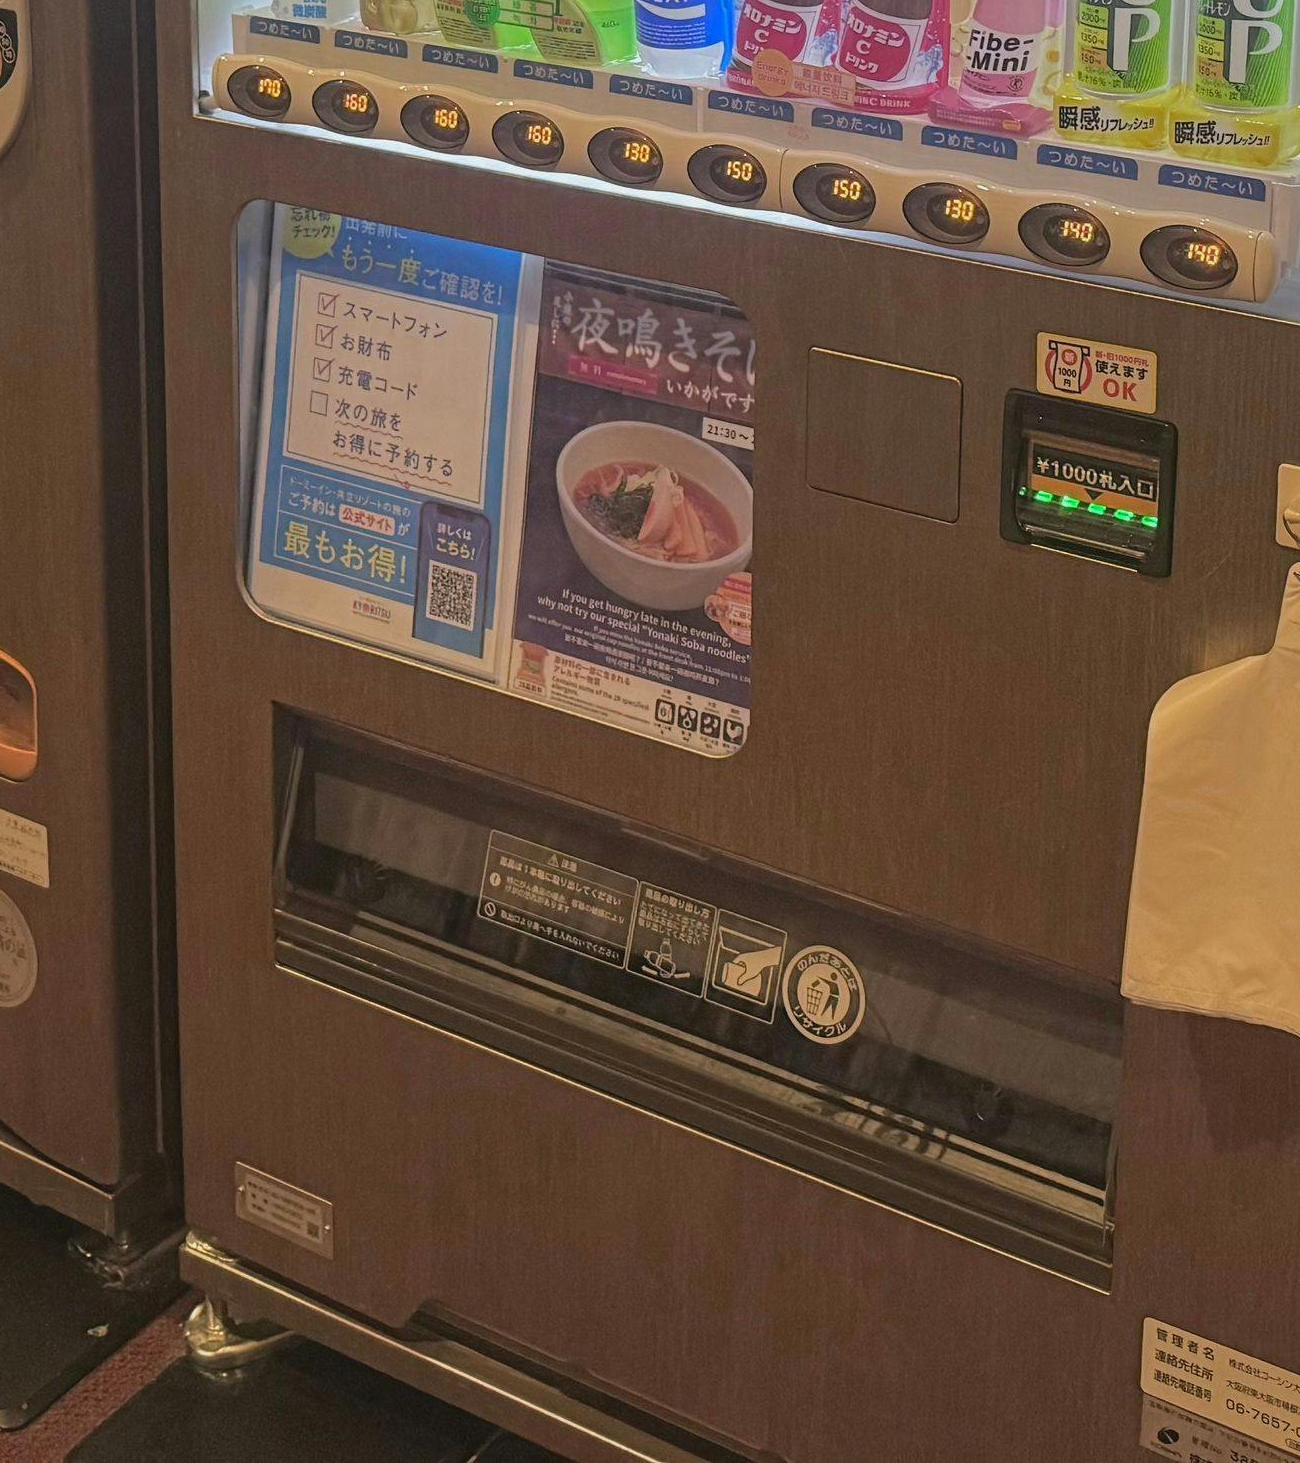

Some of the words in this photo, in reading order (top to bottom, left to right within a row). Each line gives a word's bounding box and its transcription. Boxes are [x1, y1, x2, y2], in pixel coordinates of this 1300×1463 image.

[856, 41, 871, 54] C
[845, 52, 878, 73] ドリンク
[343, 94, 368, 113] 160
[434, 110, 457, 129] 160
[726, 161, 752, 181] 150
[342, 245, 502, 305] もう一度ご確認を!
[343, 302, 447, 338] スマートフォン
[340, 334, 392, 361] お財布
[1058, 367, 1076, 378] 1000
[1063, 378, 1071, 388] 円
[1095, 360, 1148, 380] 使えます
[338, 367, 419, 401] 充電コード
[1103, 379, 1137, 402] OK
[335, 398, 402, 431] 次の旅を
[333, 431, 453, 477] お得に予約する
[341, 508, 393, 532] 公式サイト
[398, 522, 409, 535] が
[285, 521, 407, 584] 最もお得!
[538, 596, 556, 612] why
[558, 601, 574, 616] not
[575, 606, 589, 620] try
[590, 612, 607, 625] our
[608, 617, 640, 635] special
[681, 637, 705, 653] Soba
[562, 588, 569, 599] If
[570, 592, 587, 605] you
[589, 597, 604, 610] get
[606, 600, 639, 621] hungry
[641, 610, 659, 626] late
[661, 617, 670, 628] in
[671, 619, 688, 634] the
[690, 627, 731, 648] evening,
